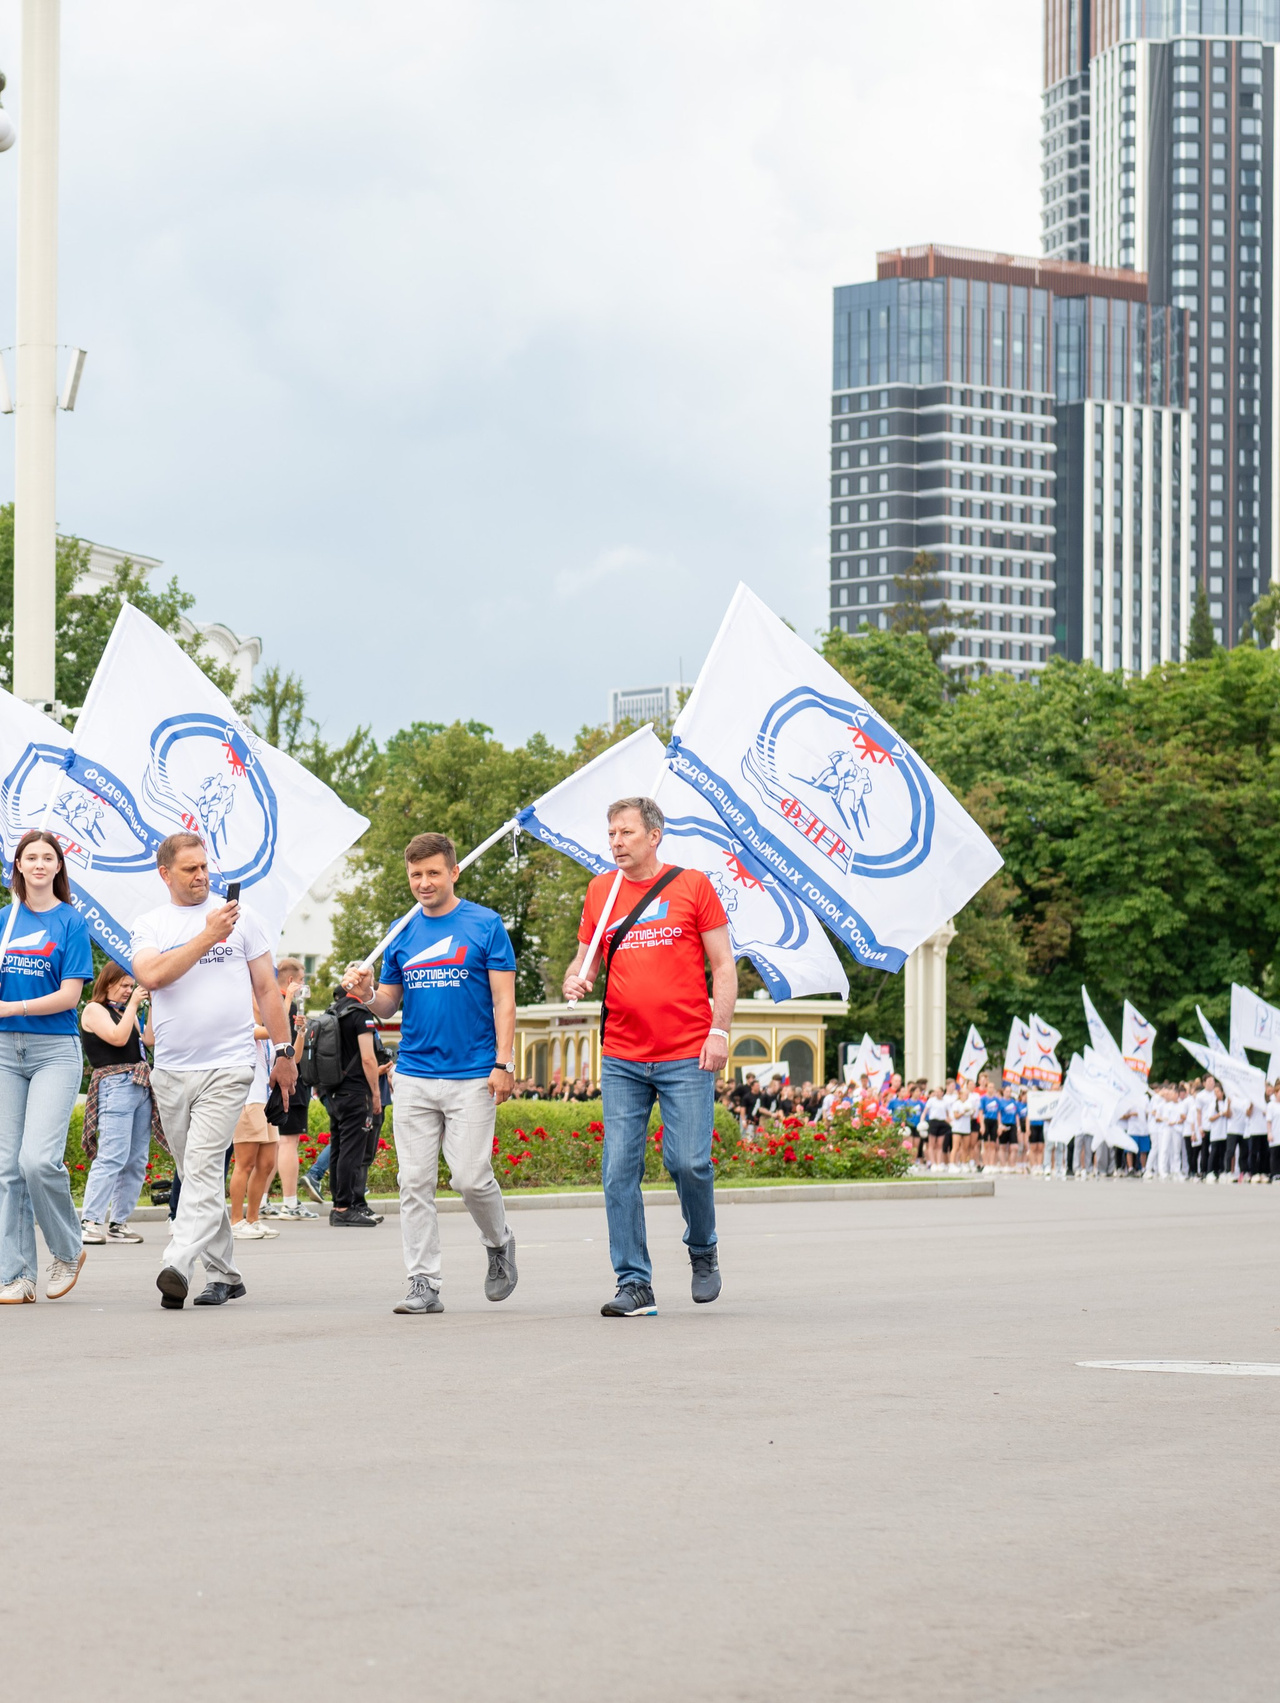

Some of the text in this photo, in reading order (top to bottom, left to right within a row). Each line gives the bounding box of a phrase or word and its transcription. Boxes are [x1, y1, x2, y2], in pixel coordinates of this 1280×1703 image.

[83, 768, 149, 841] Федерация
[780, 797, 846, 858] ФЛГР
[676, 756, 888, 962] едерация лыжных гонок России
[408, 980, 461, 989] ШЕСТВИЕ
